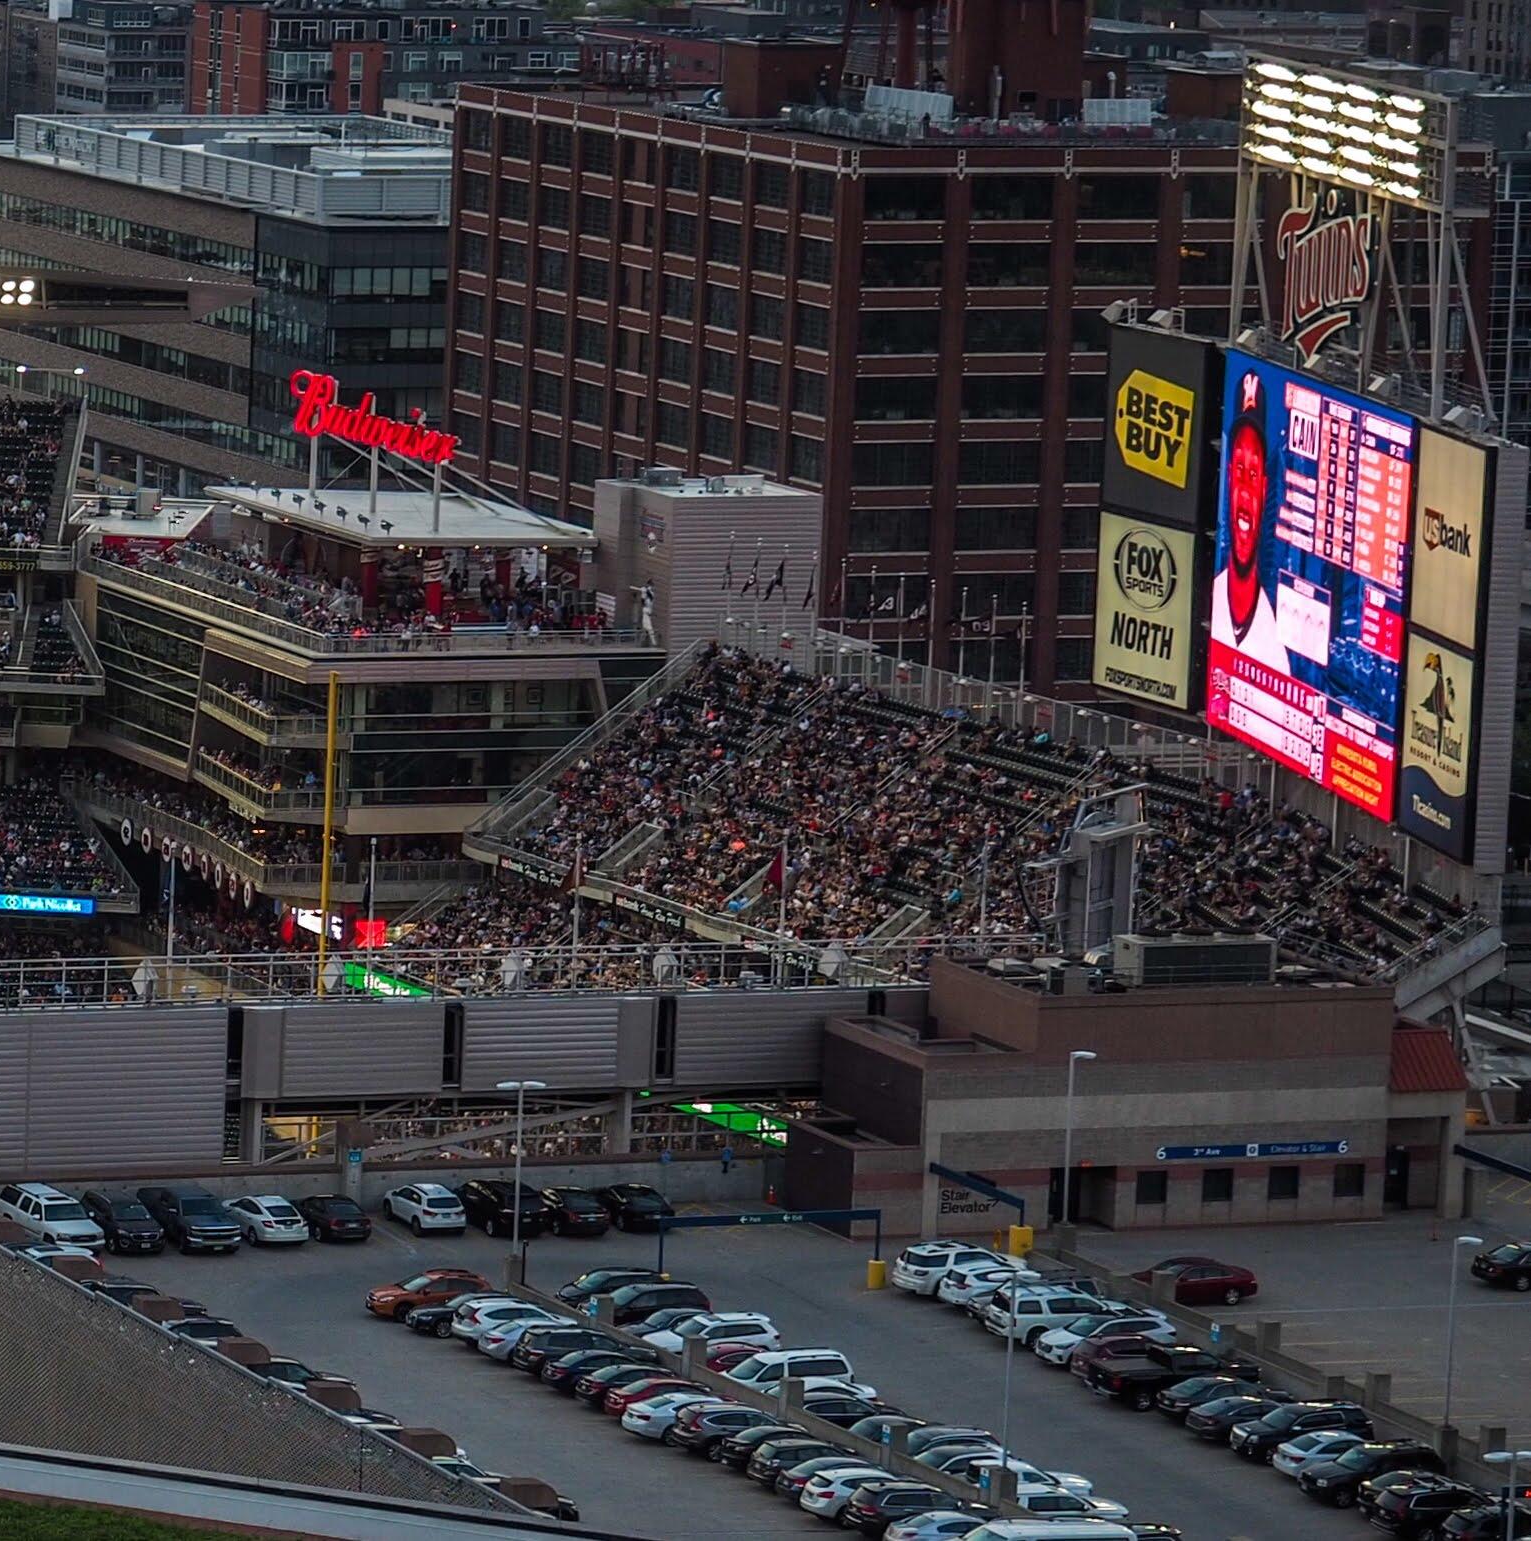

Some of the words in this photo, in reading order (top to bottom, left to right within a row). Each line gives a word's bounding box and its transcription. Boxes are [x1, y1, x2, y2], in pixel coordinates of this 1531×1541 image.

[1277, 188, 1371, 343] Twins
[290, 369, 462, 465] Budweiser
[1125, 385, 1191, 438] BEST
[1125, 419, 1183, 468] BUY
[1291, 414, 1317, 456] CAIN
[1126, 541, 1164, 583] FOX
[1124, 575, 1165, 598] SPORTS
[1109, 610, 1175, 661] NORTH
[22, 898, 44, 911] Park
[44, 900, 82, 912] Nicollet
[1156, 1146, 1167, 1160] 6
[1337, 1140, 1349, 1154] 6
[940, 1201, 993, 1214] Elevator
[941, 1189, 971, 1201] Stair
